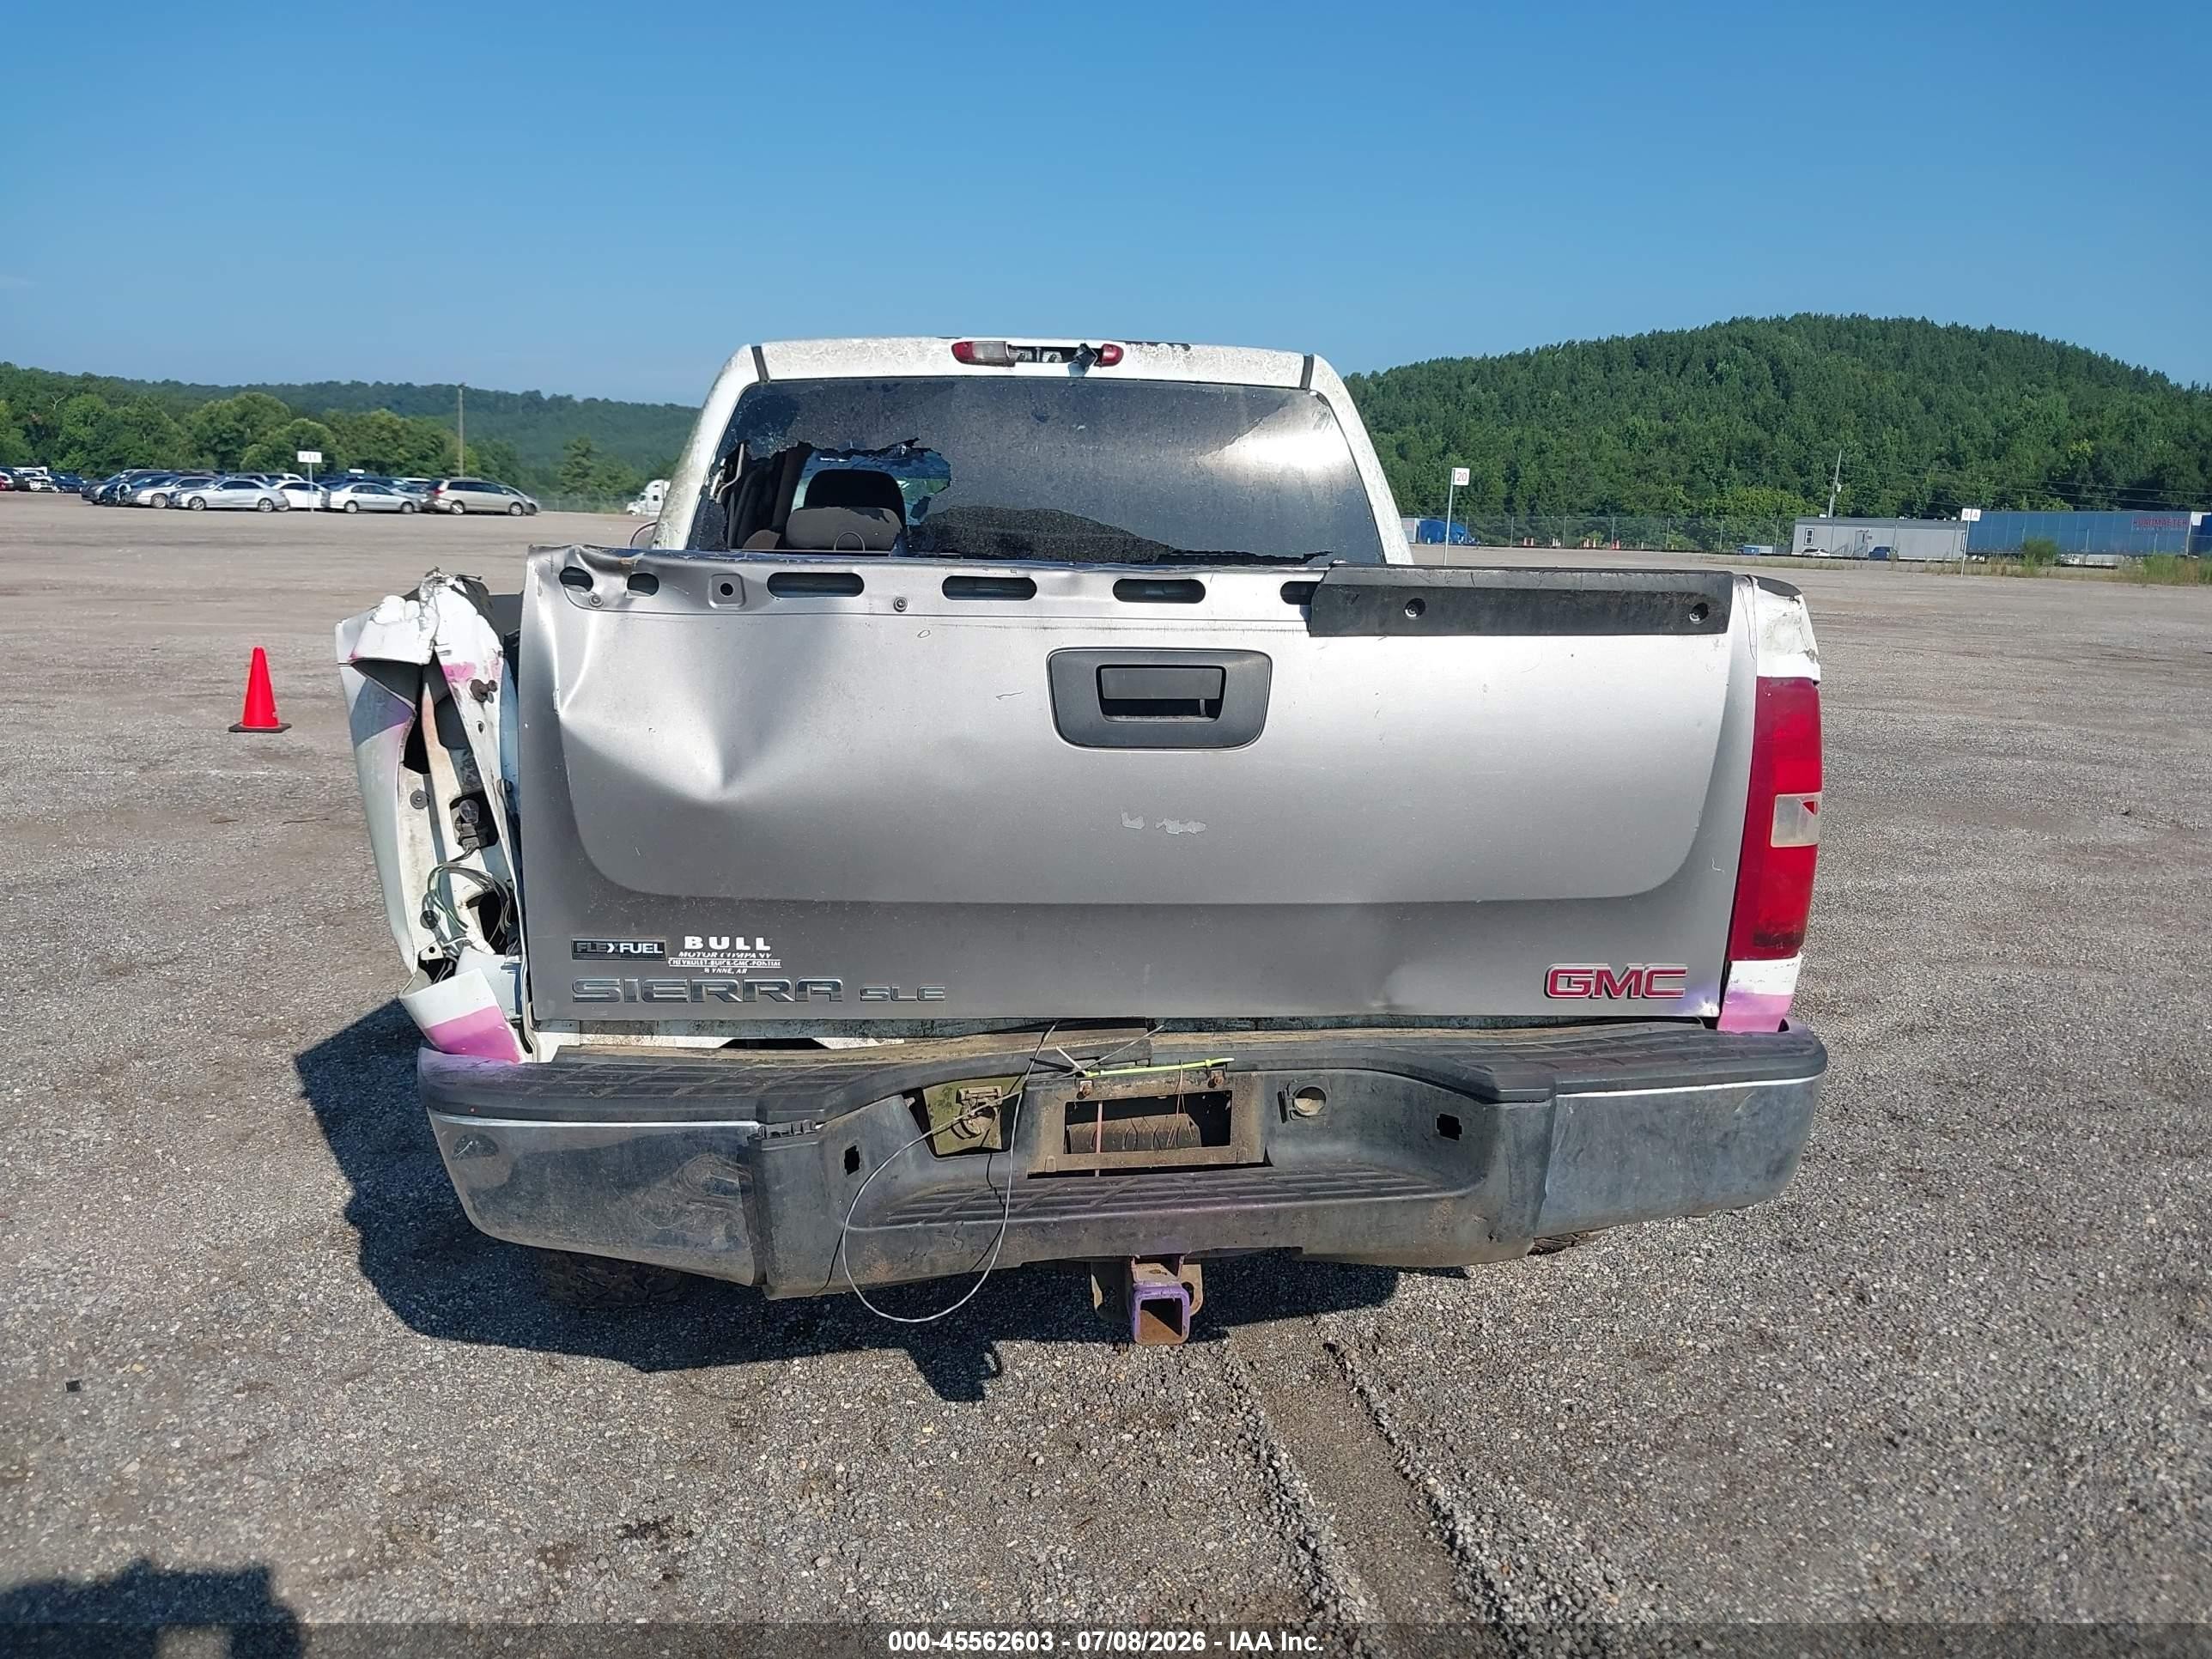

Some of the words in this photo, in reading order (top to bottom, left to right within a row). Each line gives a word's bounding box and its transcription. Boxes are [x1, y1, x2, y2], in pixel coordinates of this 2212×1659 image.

[1456, 472, 1468, 481] 20
[684, 935, 771, 951] BULL
[572, 977, 844, 1003] SIERRA
[1544, 963, 1688, 1000] GMC
[860, 984, 947, 1002] SLE
